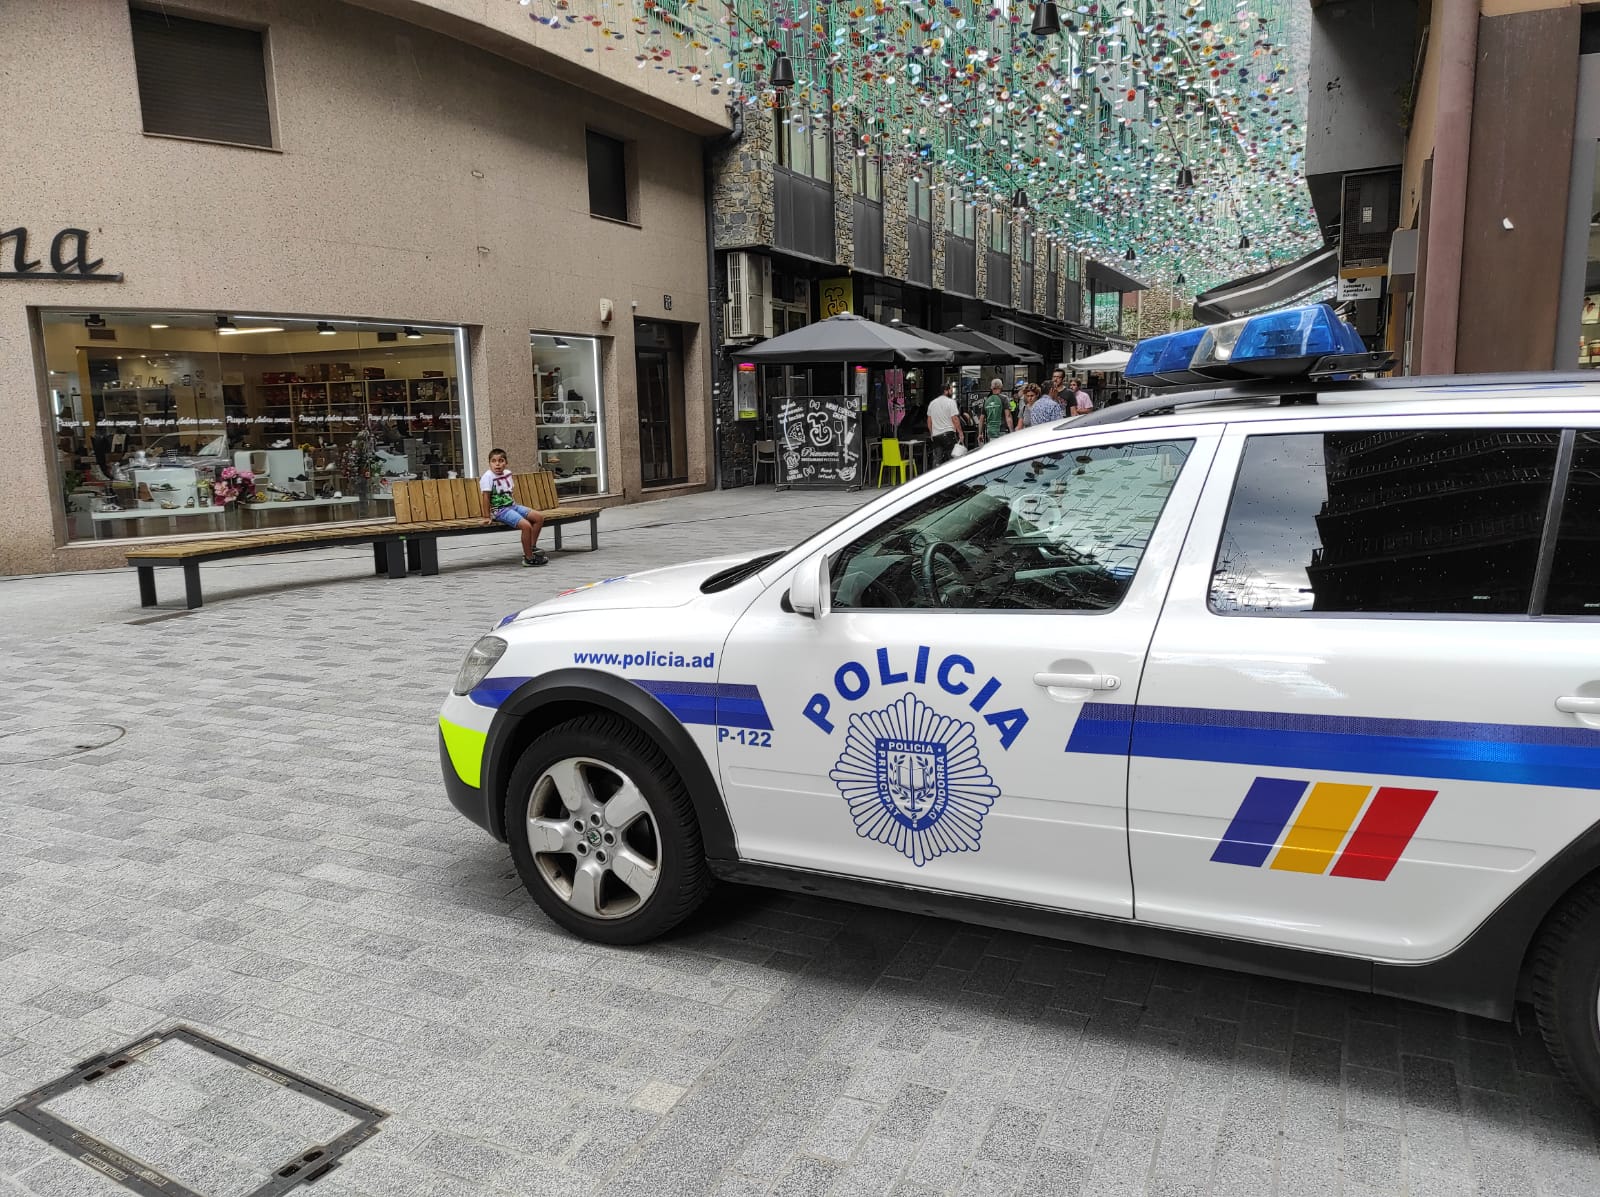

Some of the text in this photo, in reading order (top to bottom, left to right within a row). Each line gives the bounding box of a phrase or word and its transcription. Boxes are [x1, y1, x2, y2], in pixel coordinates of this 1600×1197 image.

[574, 651, 715, 669] www.policia.ad
[802, 645, 1029, 752] POLICIA
[718, 727, 772, 748] P-122
[888, 741, 934, 754] POLICIA
[878, 750, 901, 816] PRINCIPAT
[928, 755, 946, 820] D'ANDORRA
